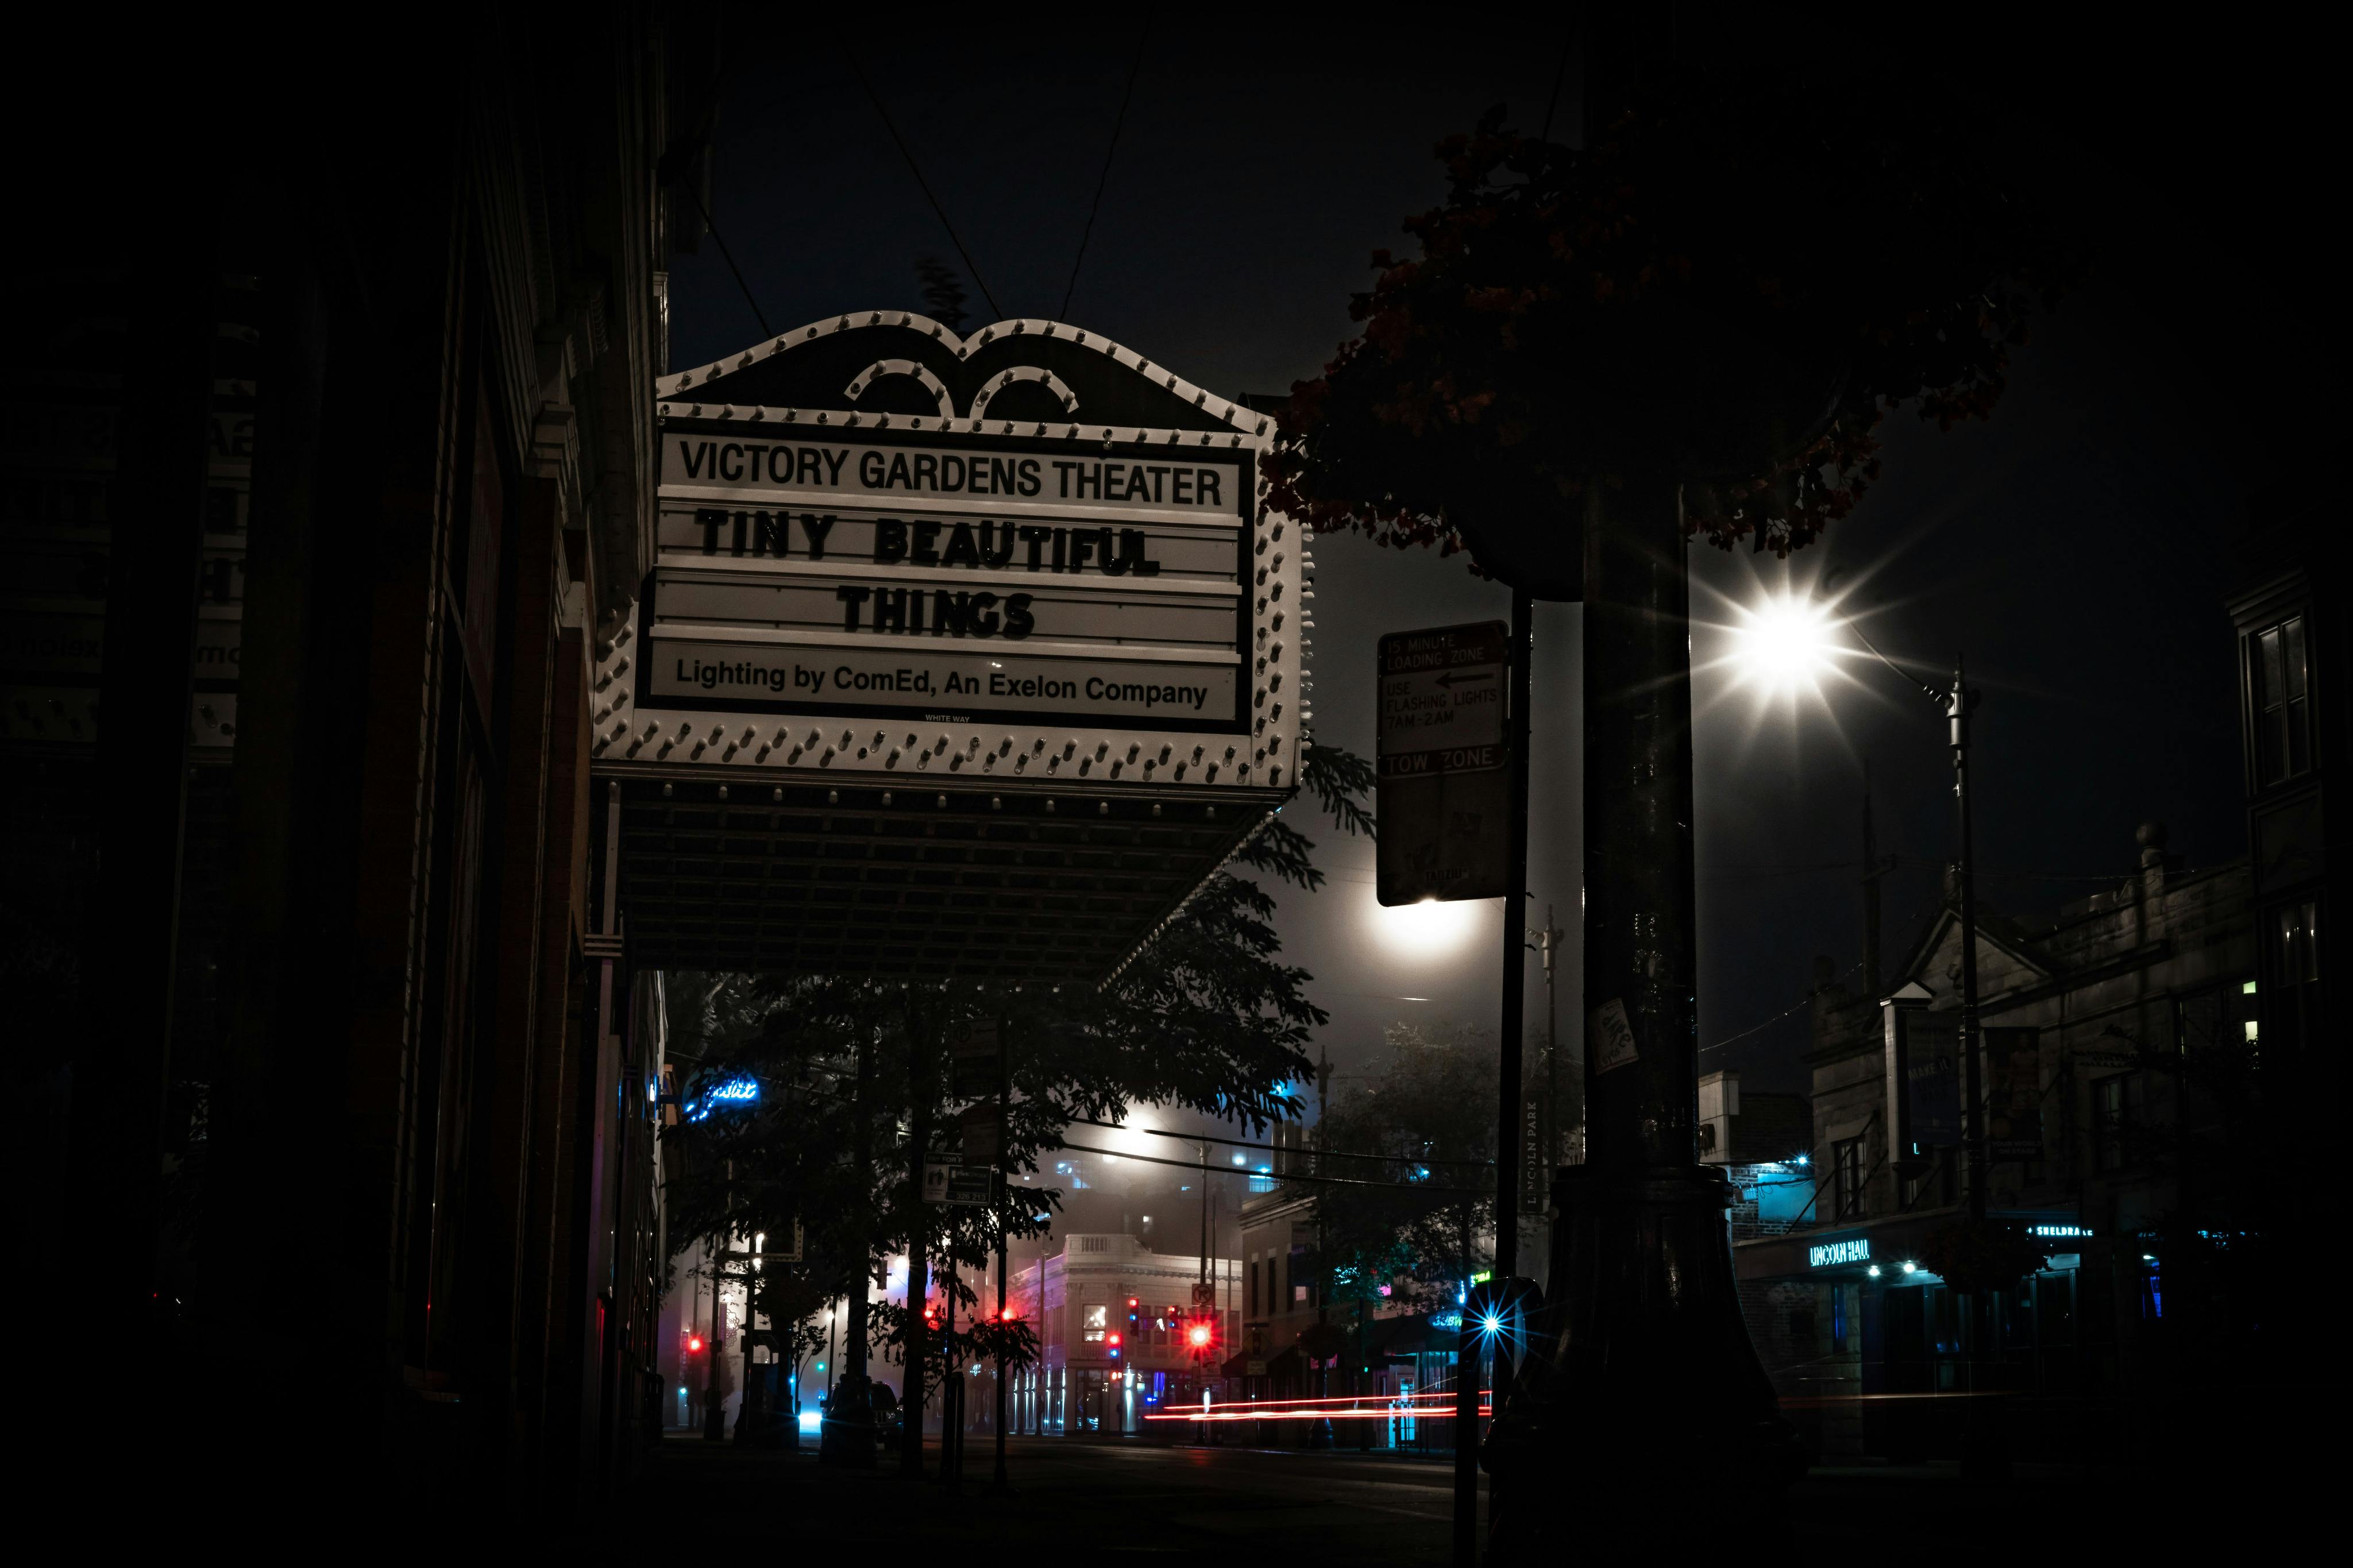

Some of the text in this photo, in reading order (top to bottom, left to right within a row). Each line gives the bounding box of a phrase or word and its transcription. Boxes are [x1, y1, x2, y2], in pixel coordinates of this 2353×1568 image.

[680, 441, 1221, 505] VICTORY GARDENS THEATER
[696, 508, 1159, 575] TINY BEAUTIFUL
[837, 586, 1033, 638] THINGS
[1387, 634, 1456, 654] 15 MINUTE
[1387, 647, 1484, 671] LOADING ZONE
[677, 659, 1208, 709] Lighting by ComEd, An Exelon Company
[1387, 682, 1410, 696] USE
[1387, 689, 1496, 713] FLASHING LIGHTS
[925, 714, 970, 723] WHITE WAY
[1386, 747, 1494, 774] TOW ZONE
[1908, 1063, 1937, 1080] MAKE
[1527, 1102, 1536, 1204] LNCOLN PARK
[2037, 1227, 2093, 1235] SHELDRAE
[1810, 1239, 1869, 1266] LINCOLN HALL
[1432, 1316, 1462, 1326] SUBW
